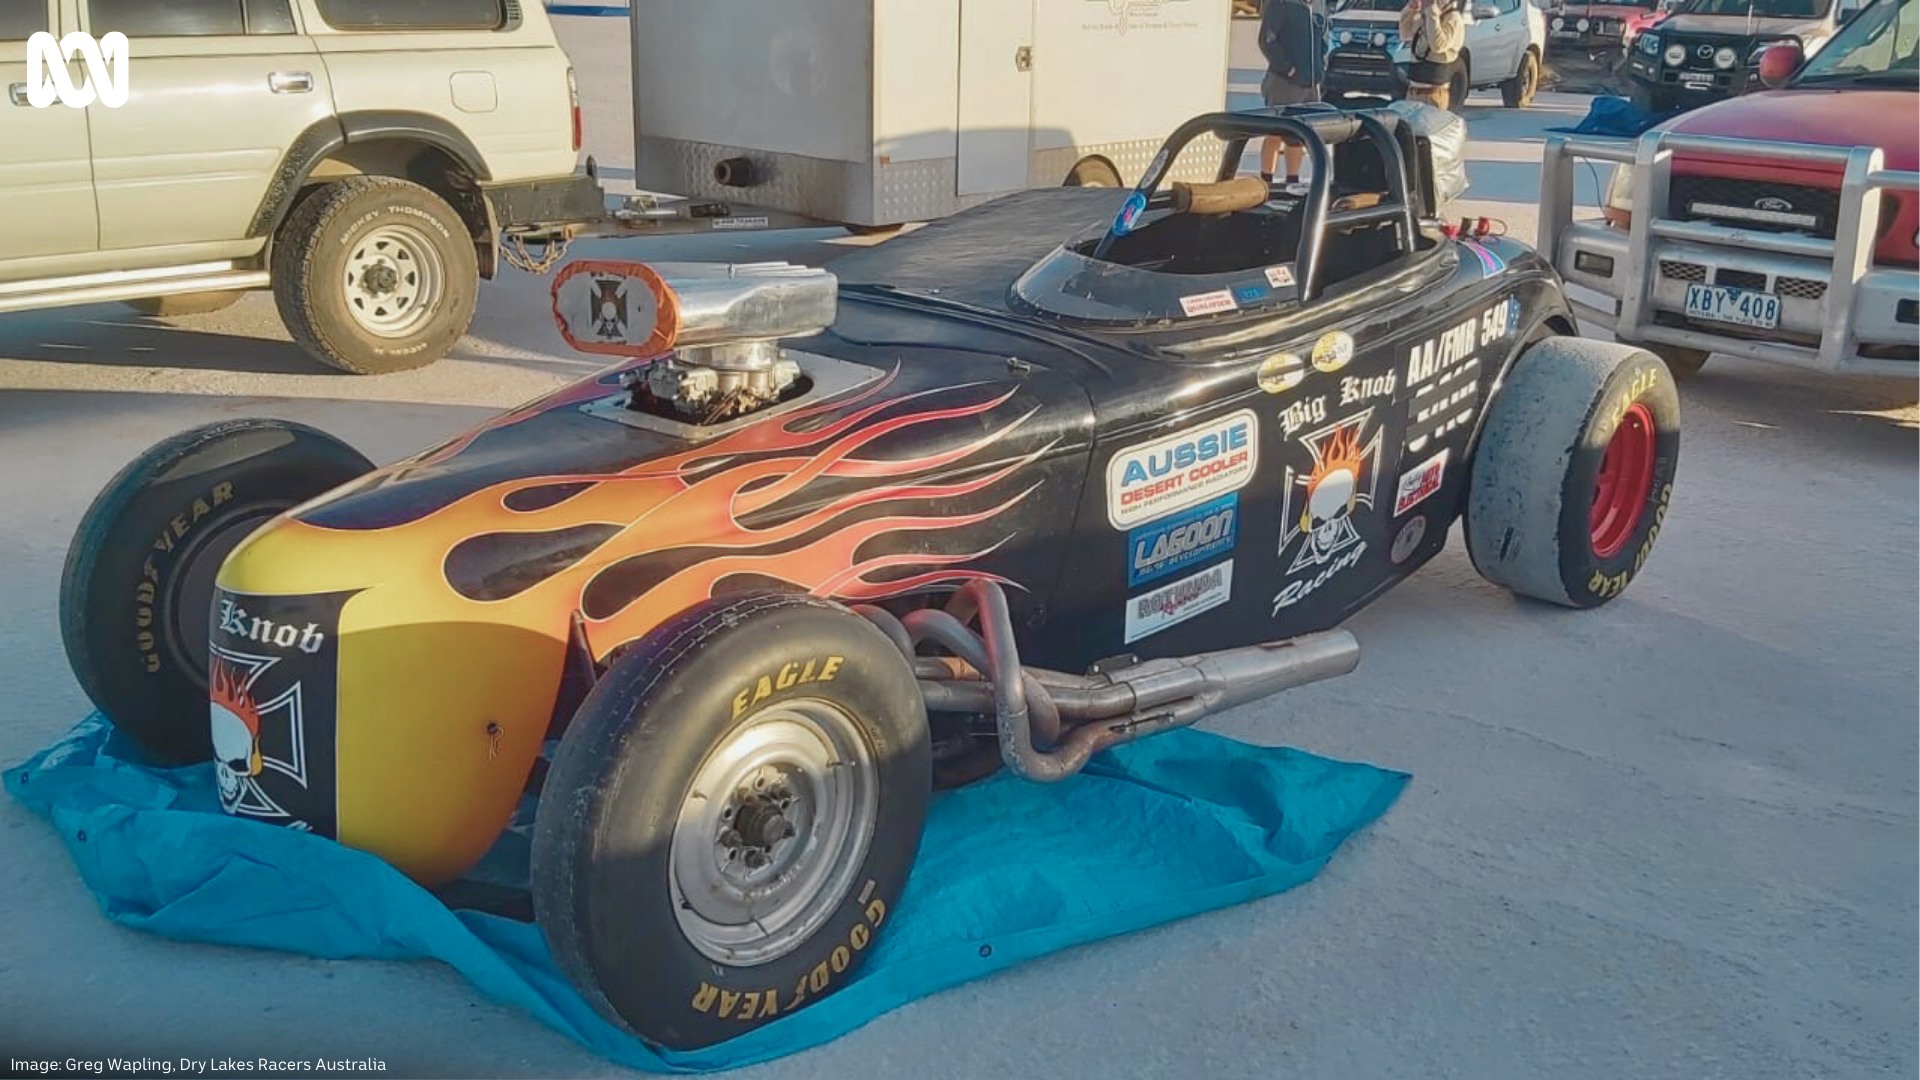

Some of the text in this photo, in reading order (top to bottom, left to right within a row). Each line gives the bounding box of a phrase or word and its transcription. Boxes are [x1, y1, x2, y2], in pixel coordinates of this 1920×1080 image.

[340, 205, 450, 245] MICKEY THOMPSON
[1689, 287, 1776, 320] XBY 408
[1406, 317, 1477, 388] AA/FMR
[1480, 299, 1508, 347] 549
[1277, 395, 1327, 439] Big
[1338, 368, 1397, 407] Knob
[1611, 367, 1658, 427] EAGLE
[1120, 422, 1248, 488] AUSSIE
[1120, 450, 1249, 505] DESERT COOLER
[1120, 503, 1143, 515] HIGH
[1143, 482, 1205, 508] PERFORMANCE
[1272, 540, 1369, 618] Racing
[219, 599, 324, 654] Knob
[731, 655, 844, 721] EAGLE
